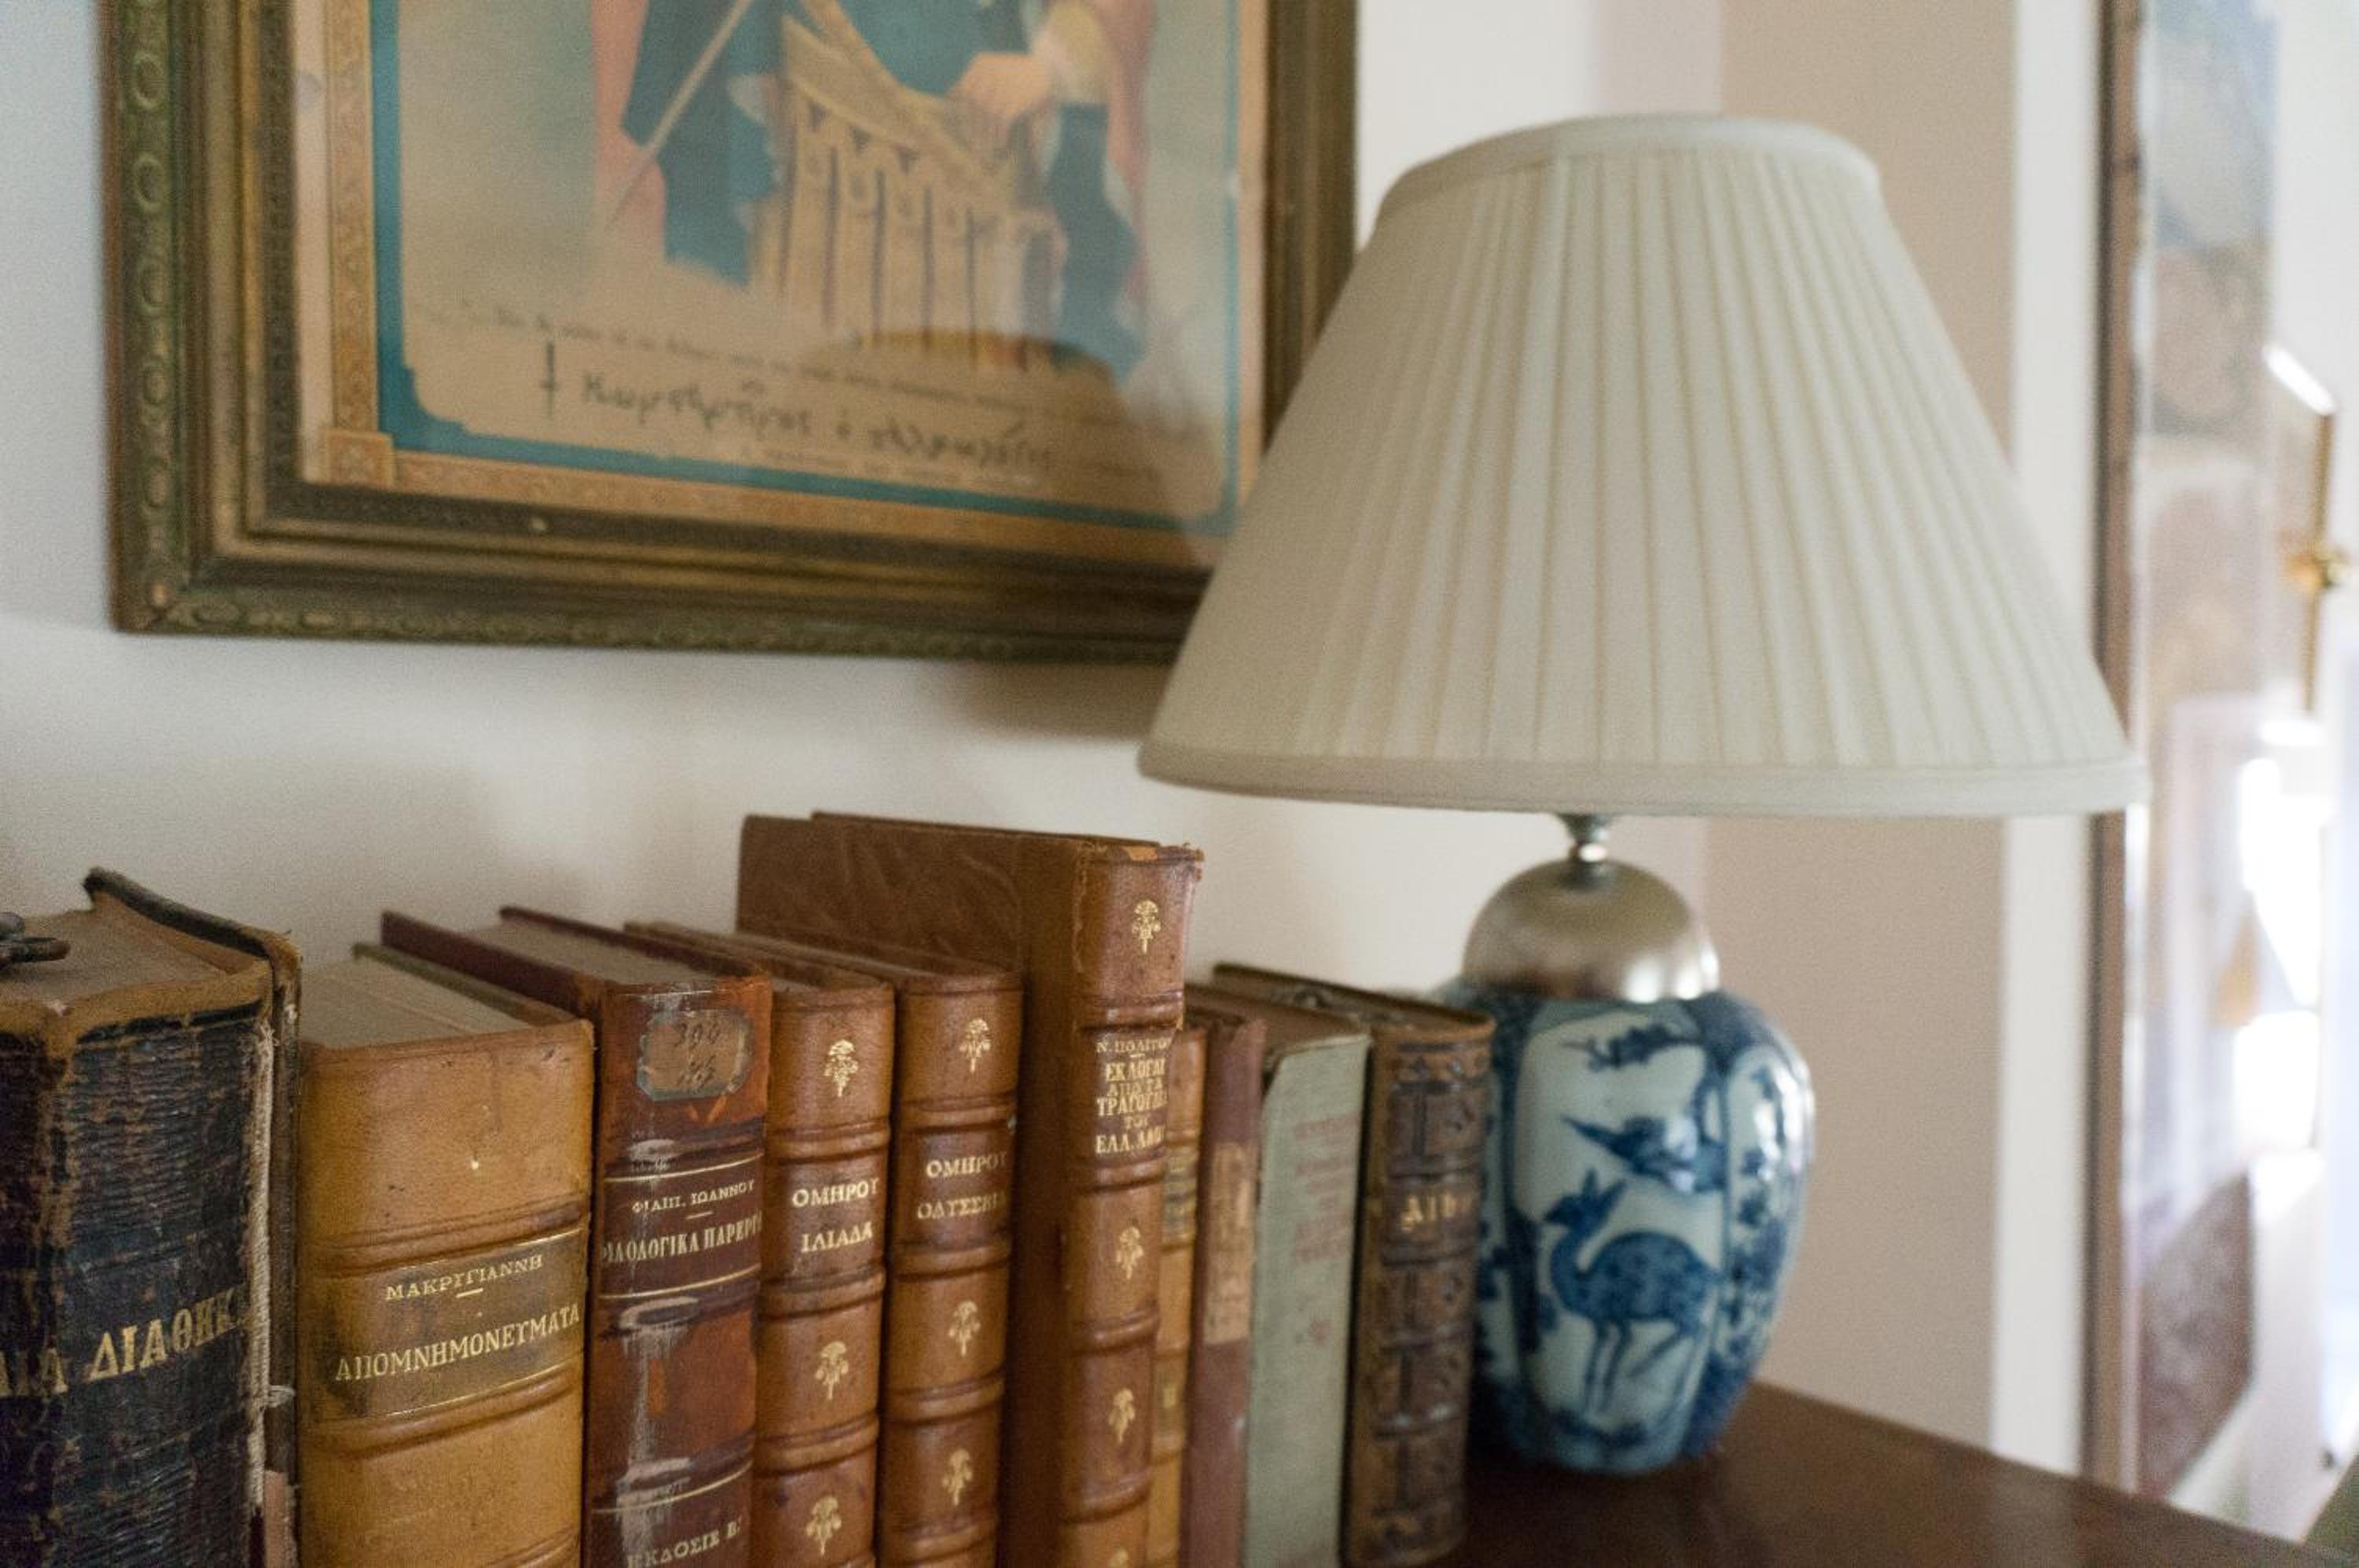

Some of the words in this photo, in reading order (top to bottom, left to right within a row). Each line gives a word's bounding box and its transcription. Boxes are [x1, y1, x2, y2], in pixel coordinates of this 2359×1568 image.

[926, 1151, 1007, 1178] ΟΜΗΡΟΥ
[691, 1179, 755, 1205] ΙΩΑΝΝΟΥ
[792, 1177, 880, 1208] ΟΜΗΡΟΥ
[800, 1221, 873, 1253] ΙΛΙΑΔΑ
[335, 1303, 580, 1381] ΑΠΟΜΝΗΜΟΝΕΥΜΑΤΑ
